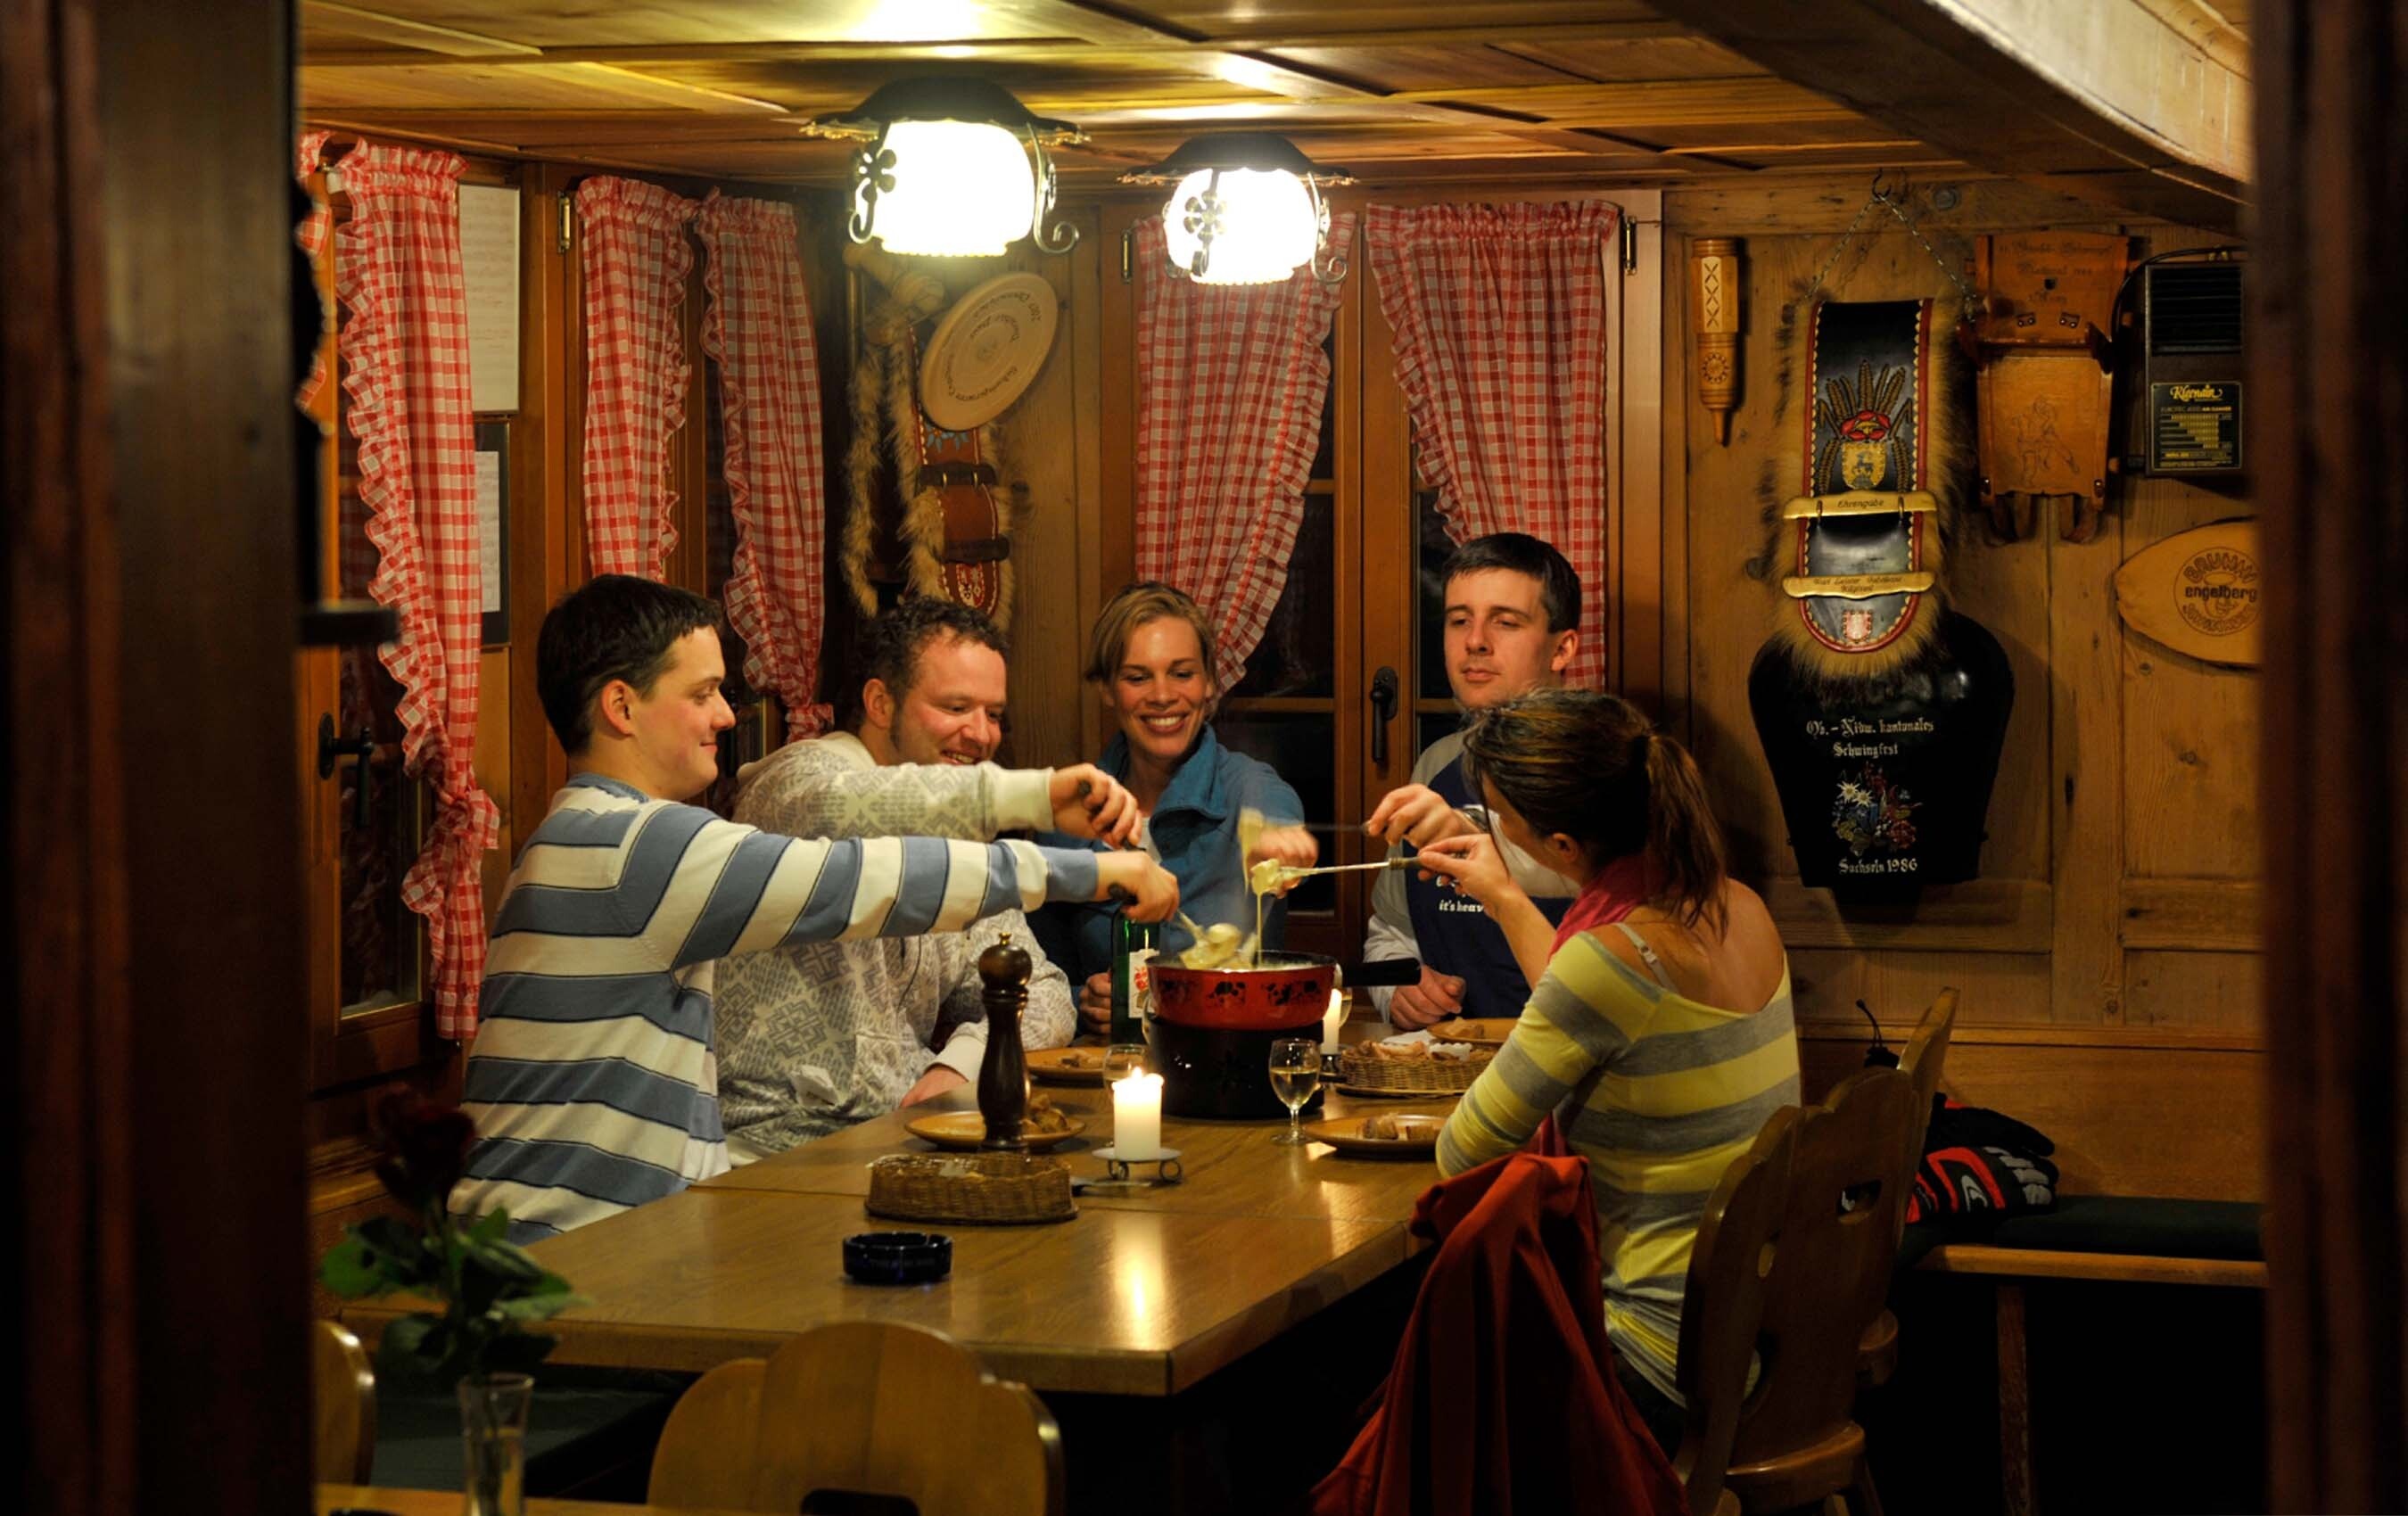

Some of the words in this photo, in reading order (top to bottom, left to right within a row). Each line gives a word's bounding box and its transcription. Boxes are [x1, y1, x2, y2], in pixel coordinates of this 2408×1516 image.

[2185, 586, 2258, 603] engelberg
[1833, 742, 1899, 758] Schwingfest
[1887, 858, 1917, 873] 1986
[1439, 899, 1456, 912] it's
[1456, 900, 1484, 912] heav
